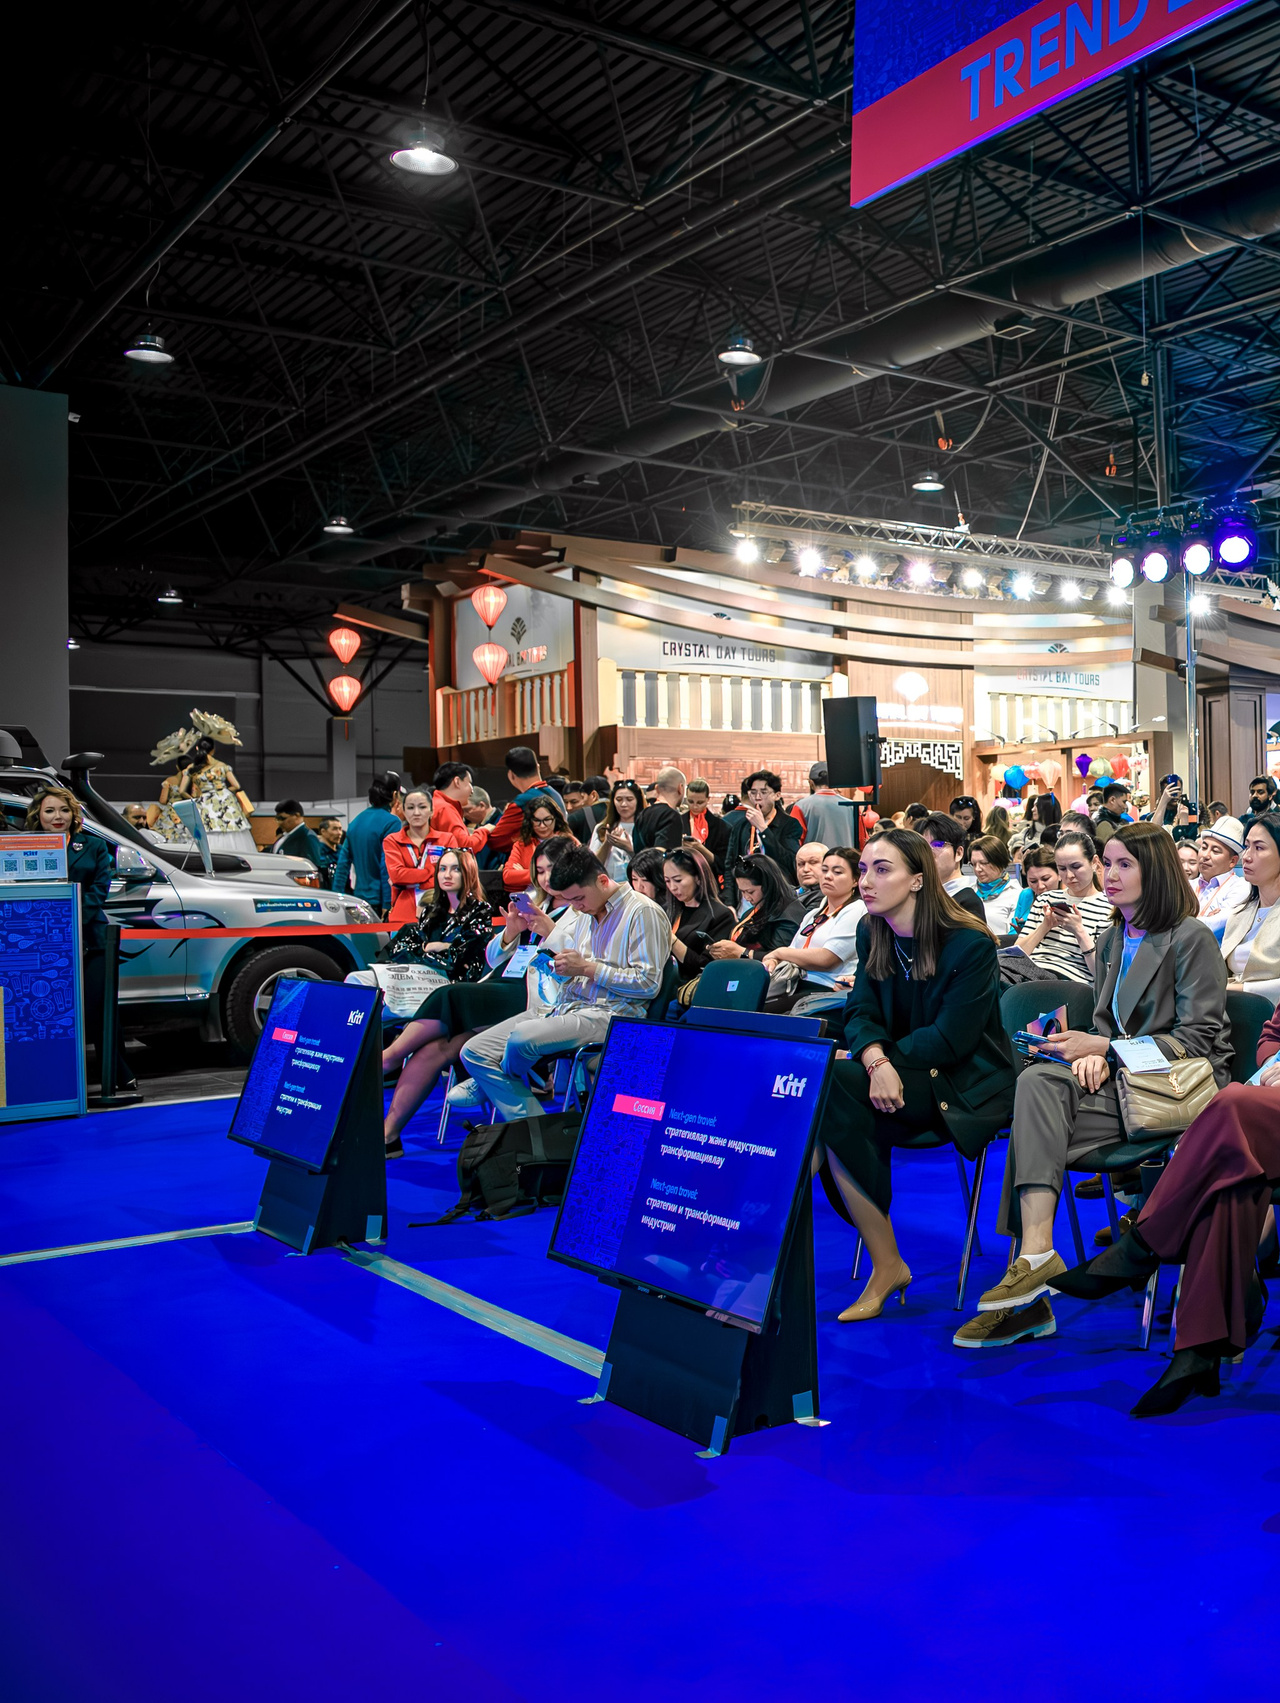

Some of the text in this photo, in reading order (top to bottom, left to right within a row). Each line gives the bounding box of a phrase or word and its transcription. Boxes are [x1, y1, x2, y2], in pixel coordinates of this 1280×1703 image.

[741, 647, 776, 663] TOURS
[1056, 671, 1072, 683] BAY
[1075, 672, 1100, 686] TOURS
[771, 1073, 807, 1098] Kitf
[633, 1101, 656, 1115] Сессия
[669, 1108, 697, 1124] Next-gen
[665, 1126, 777, 1157] стратегиялар және индустрияны
[660, 1144, 725, 1169] трансформациялау
[650, 1177, 678, 1195] Next-gen
[646, 1197, 677, 1213] стратегии
[684, 1206, 741, 1230] трансформация
[641, 1214, 676, 1232] индустрии
